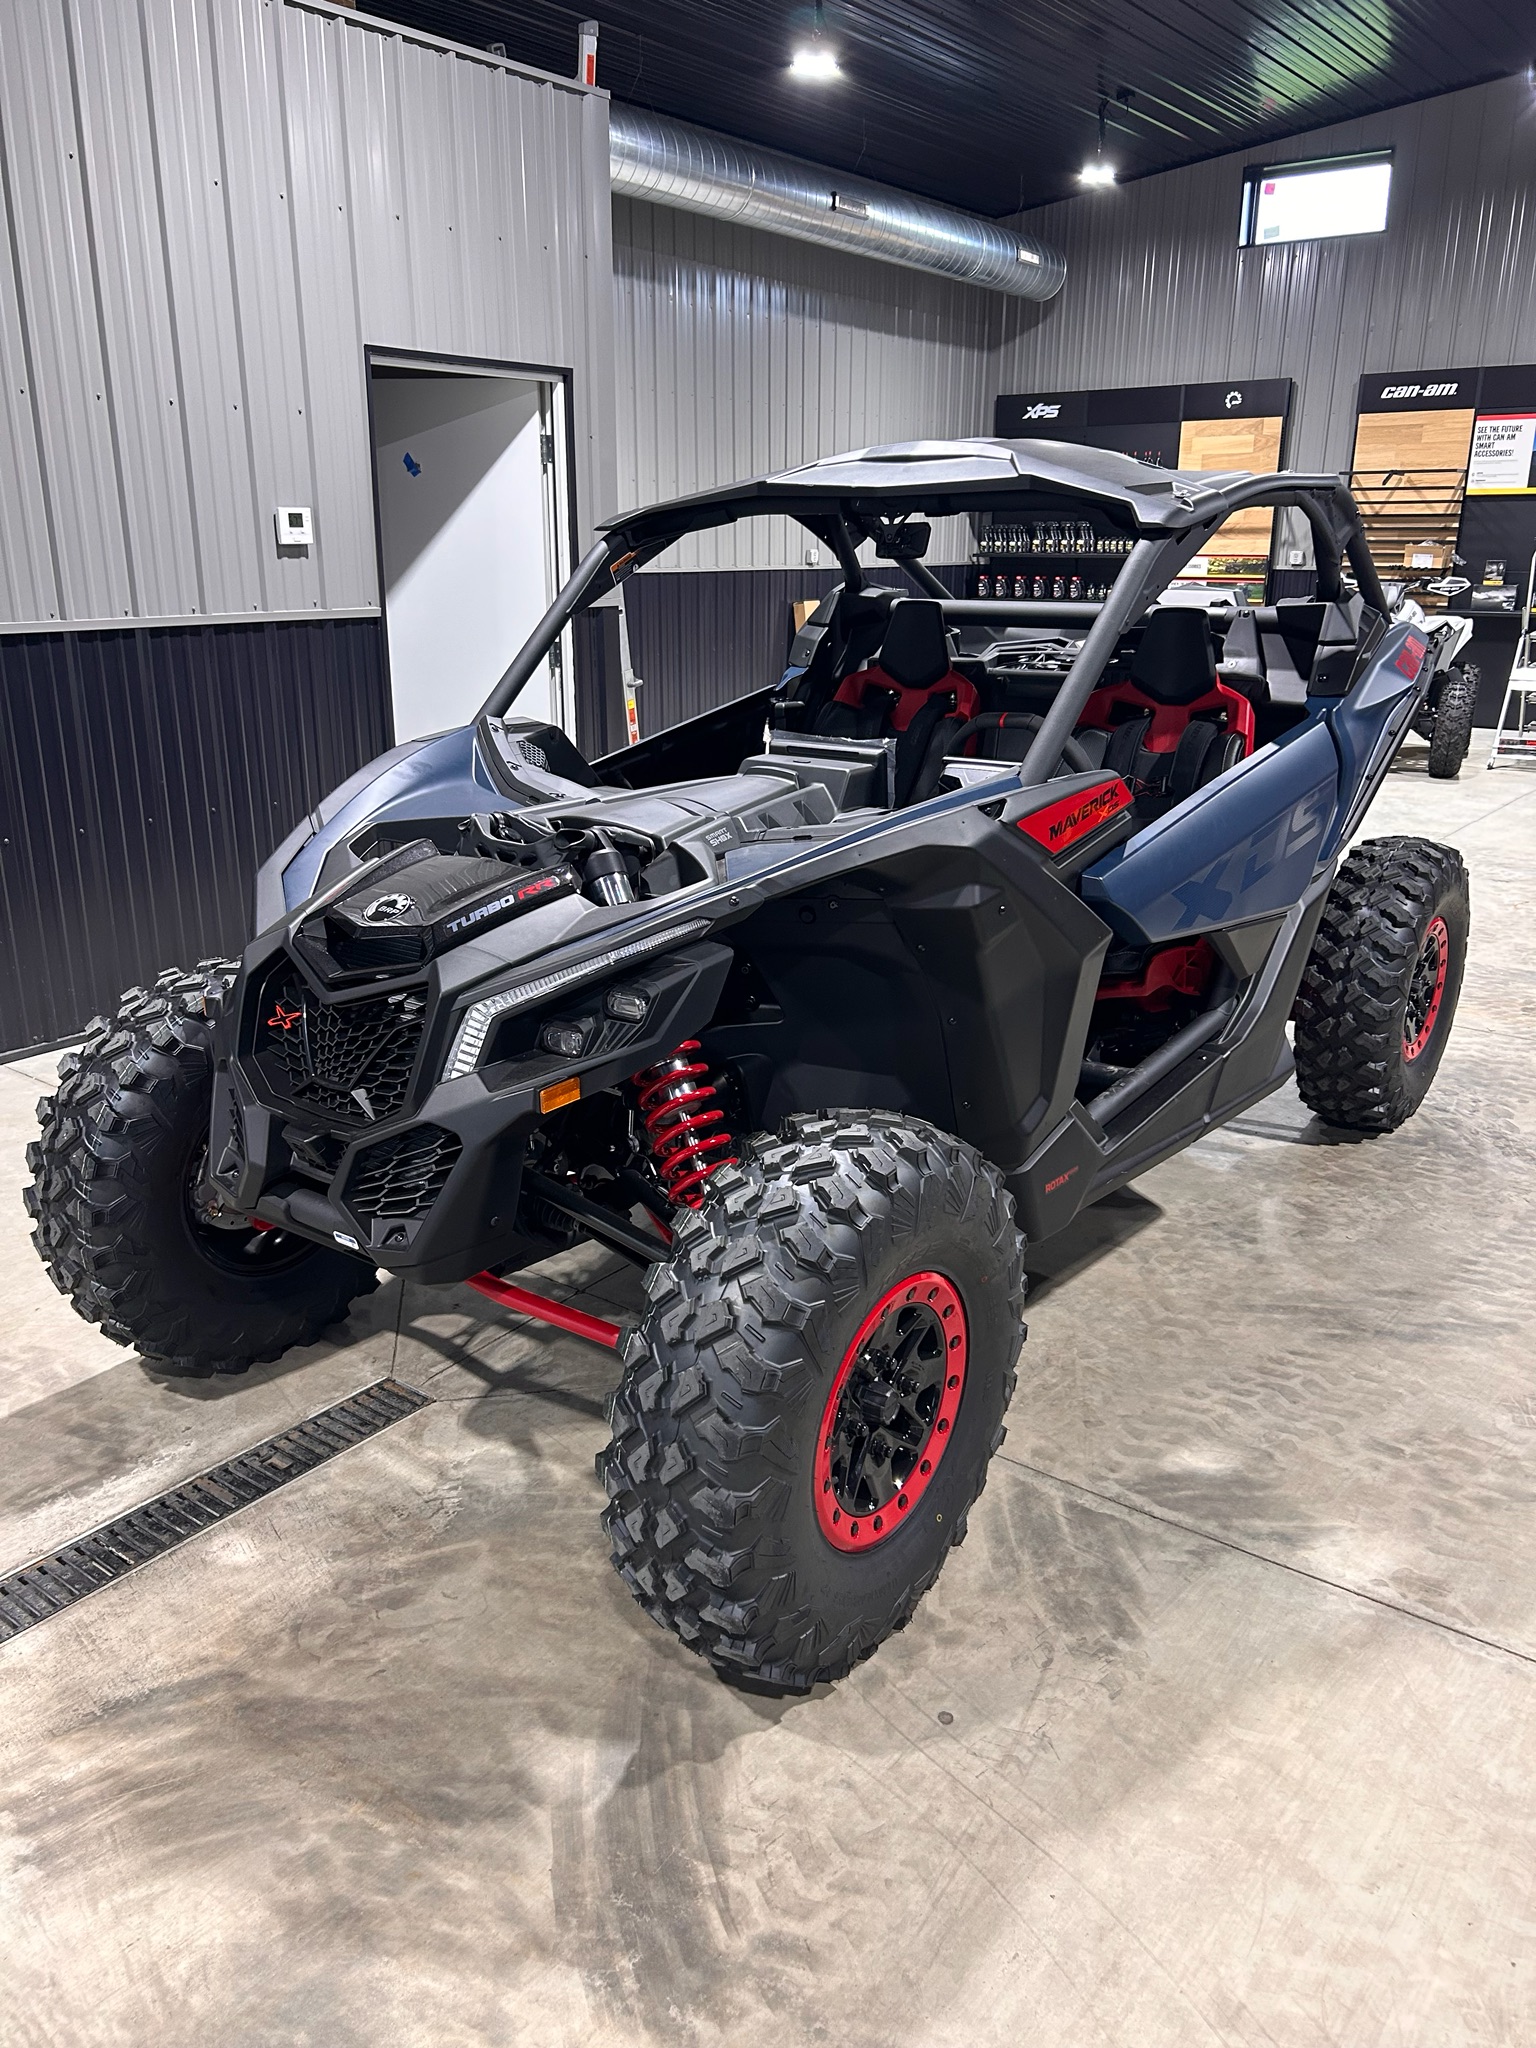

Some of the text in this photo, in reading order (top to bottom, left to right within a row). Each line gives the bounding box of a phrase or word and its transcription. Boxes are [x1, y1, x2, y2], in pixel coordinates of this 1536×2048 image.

[1022, 403, 1062, 420] XPS
[1477, 426, 1488, 434] SEE
[1501, 425, 1523, 433] FUTURE
[1476, 433, 1516, 442] WITH CAN AM
[1475, 442, 1495, 450] SMART
[1474, 449, 1514, 458] ACCESSORIES!
[1049, 783, 1120, 842] MAVERICK
[377, 905, 400, 914] BRP
[446, 877, 557, 933] TURBO RR
[1045, 1173, 1069, 1195] ROTAX
